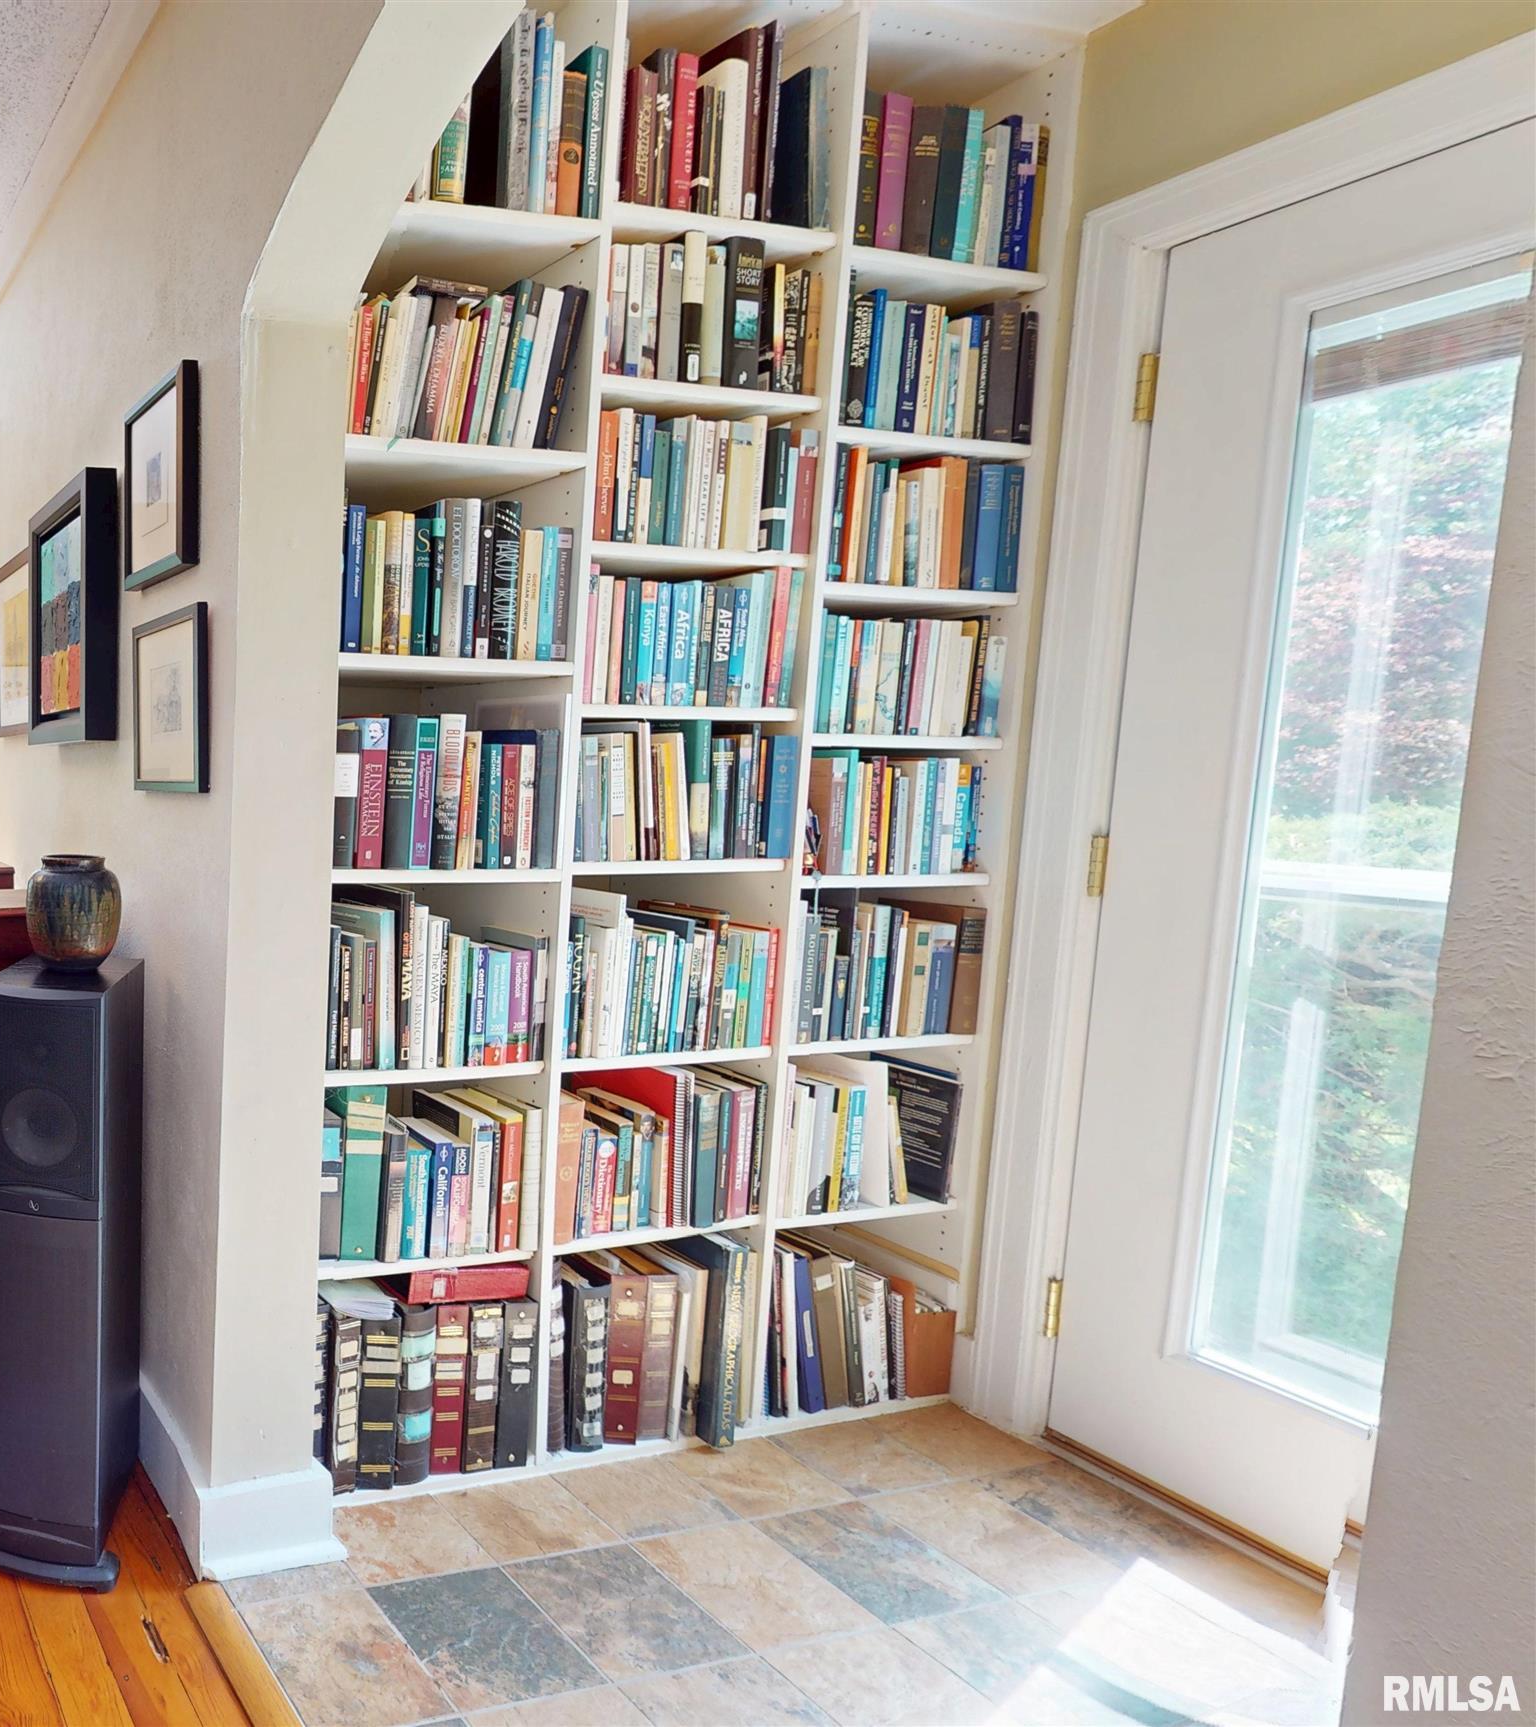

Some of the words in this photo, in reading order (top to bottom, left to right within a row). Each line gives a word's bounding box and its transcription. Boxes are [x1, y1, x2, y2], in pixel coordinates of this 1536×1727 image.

[590, 80, 604, 121] Ulysses
[687, 91, 695, 117] THE
[587, 122, 603, 186] Annotated
[735, 276, 761, 287] STORY
[736, 267, 762, 278] SHORT
[434, 324, 449, 364] BUDDHA
[849, 320, 862, 367] CONTRACT
[425, 367, 443, 414] DHAMMA
[602, 452, 613, 475] John
[600, 476, 612, 515] Cheever
[494, 540, 520, 580] HAROLD
[559, 552, 567, 577] HEART
[491, 587, 518, 634] BRODKEY
[556, 590, 565, 628] DARKNESS
[641, 608, 656, 646] Kenya
[658, 606, 668, 628] East
[656, 629, 667, 660] Africa
[674, 609, 690, 660] Africa
[716, 608, 733, 662] AFRICA
[442, 729, 461, 793] BLOODLANDS
[367, 763, 383, 838] EINSTEIN
[463, 775, 473, 807] MANTEL
[507, 778, 515, 797] ACE
[507, 797, 515, 811] OF
[506, 812, 514, 837] SPIES
[953, 793, 966, 844] Canada
[401, 958, 413, 1001] MAYA
[415, 951, 425, 998] ANCIENT
[431, 952, 440, 970] The
[440, 949, 449, 986] MEXICO
[521, 961, 529, 982] South
[572, 933, 585, 994] HOGAN
[805, 933, 816, 992] ROUGHING
[430, 972, 439, 1004] MAYA
[477, 968, 487, 998] central
[514, 962, 522, 999] Handbook
[475, 999, 484, 1033] america
[520, 983, 528, 1016] American
[803, 999, 811, 1011] IT
[413, 1002, 423, 1045] MEXICO
[459, 1148, 467, 1174] MOON
[477, 1143, 490, 1189] Vermont
[435, 1166, 449, 1217] California
[594, 1159, 609, 1215] Dictionary
[730, 1285, 742, 1313] NEW
[721, 1399, 733, 1430] ATLAS
